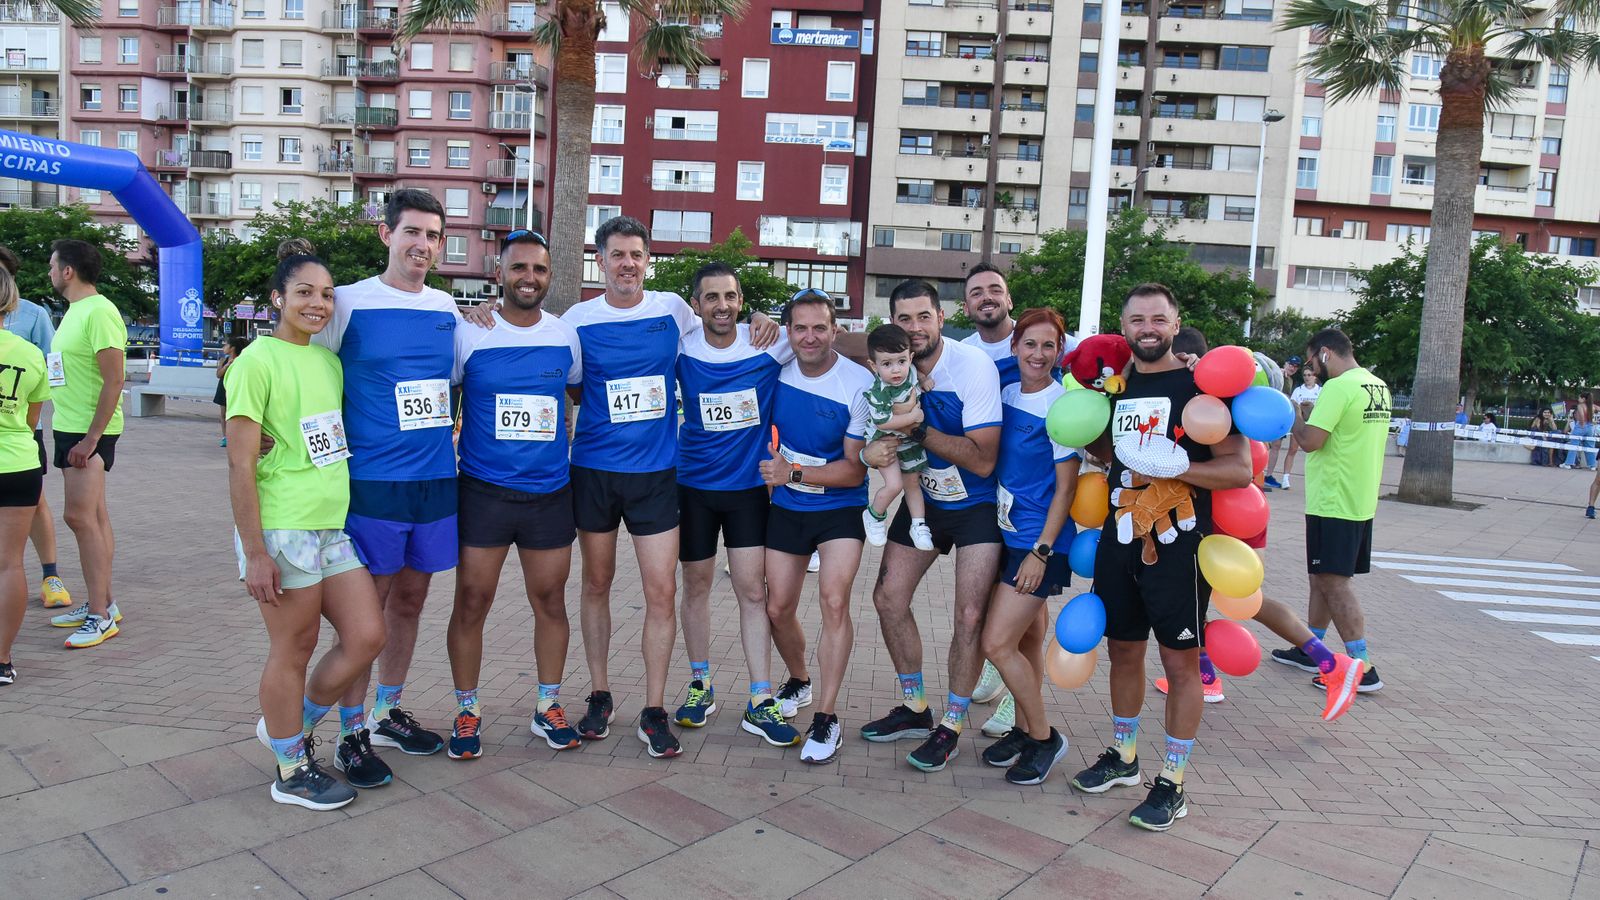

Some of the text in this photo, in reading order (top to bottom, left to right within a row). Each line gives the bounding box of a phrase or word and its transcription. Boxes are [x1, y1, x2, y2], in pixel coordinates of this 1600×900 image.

[795, 31, 848, 45] mertramar
[398, 385, 410, 394] XXI
[404, 397, 433, 417] 536
[499, 398, 511, 406] XXI
[613, 393, 640, 411] 417
[501, 410, 531, 427] 679
[706, 406, 732, 421] 126
[1117, 414, 1141, 432] 120
[309, 432, 331, 453] 556
